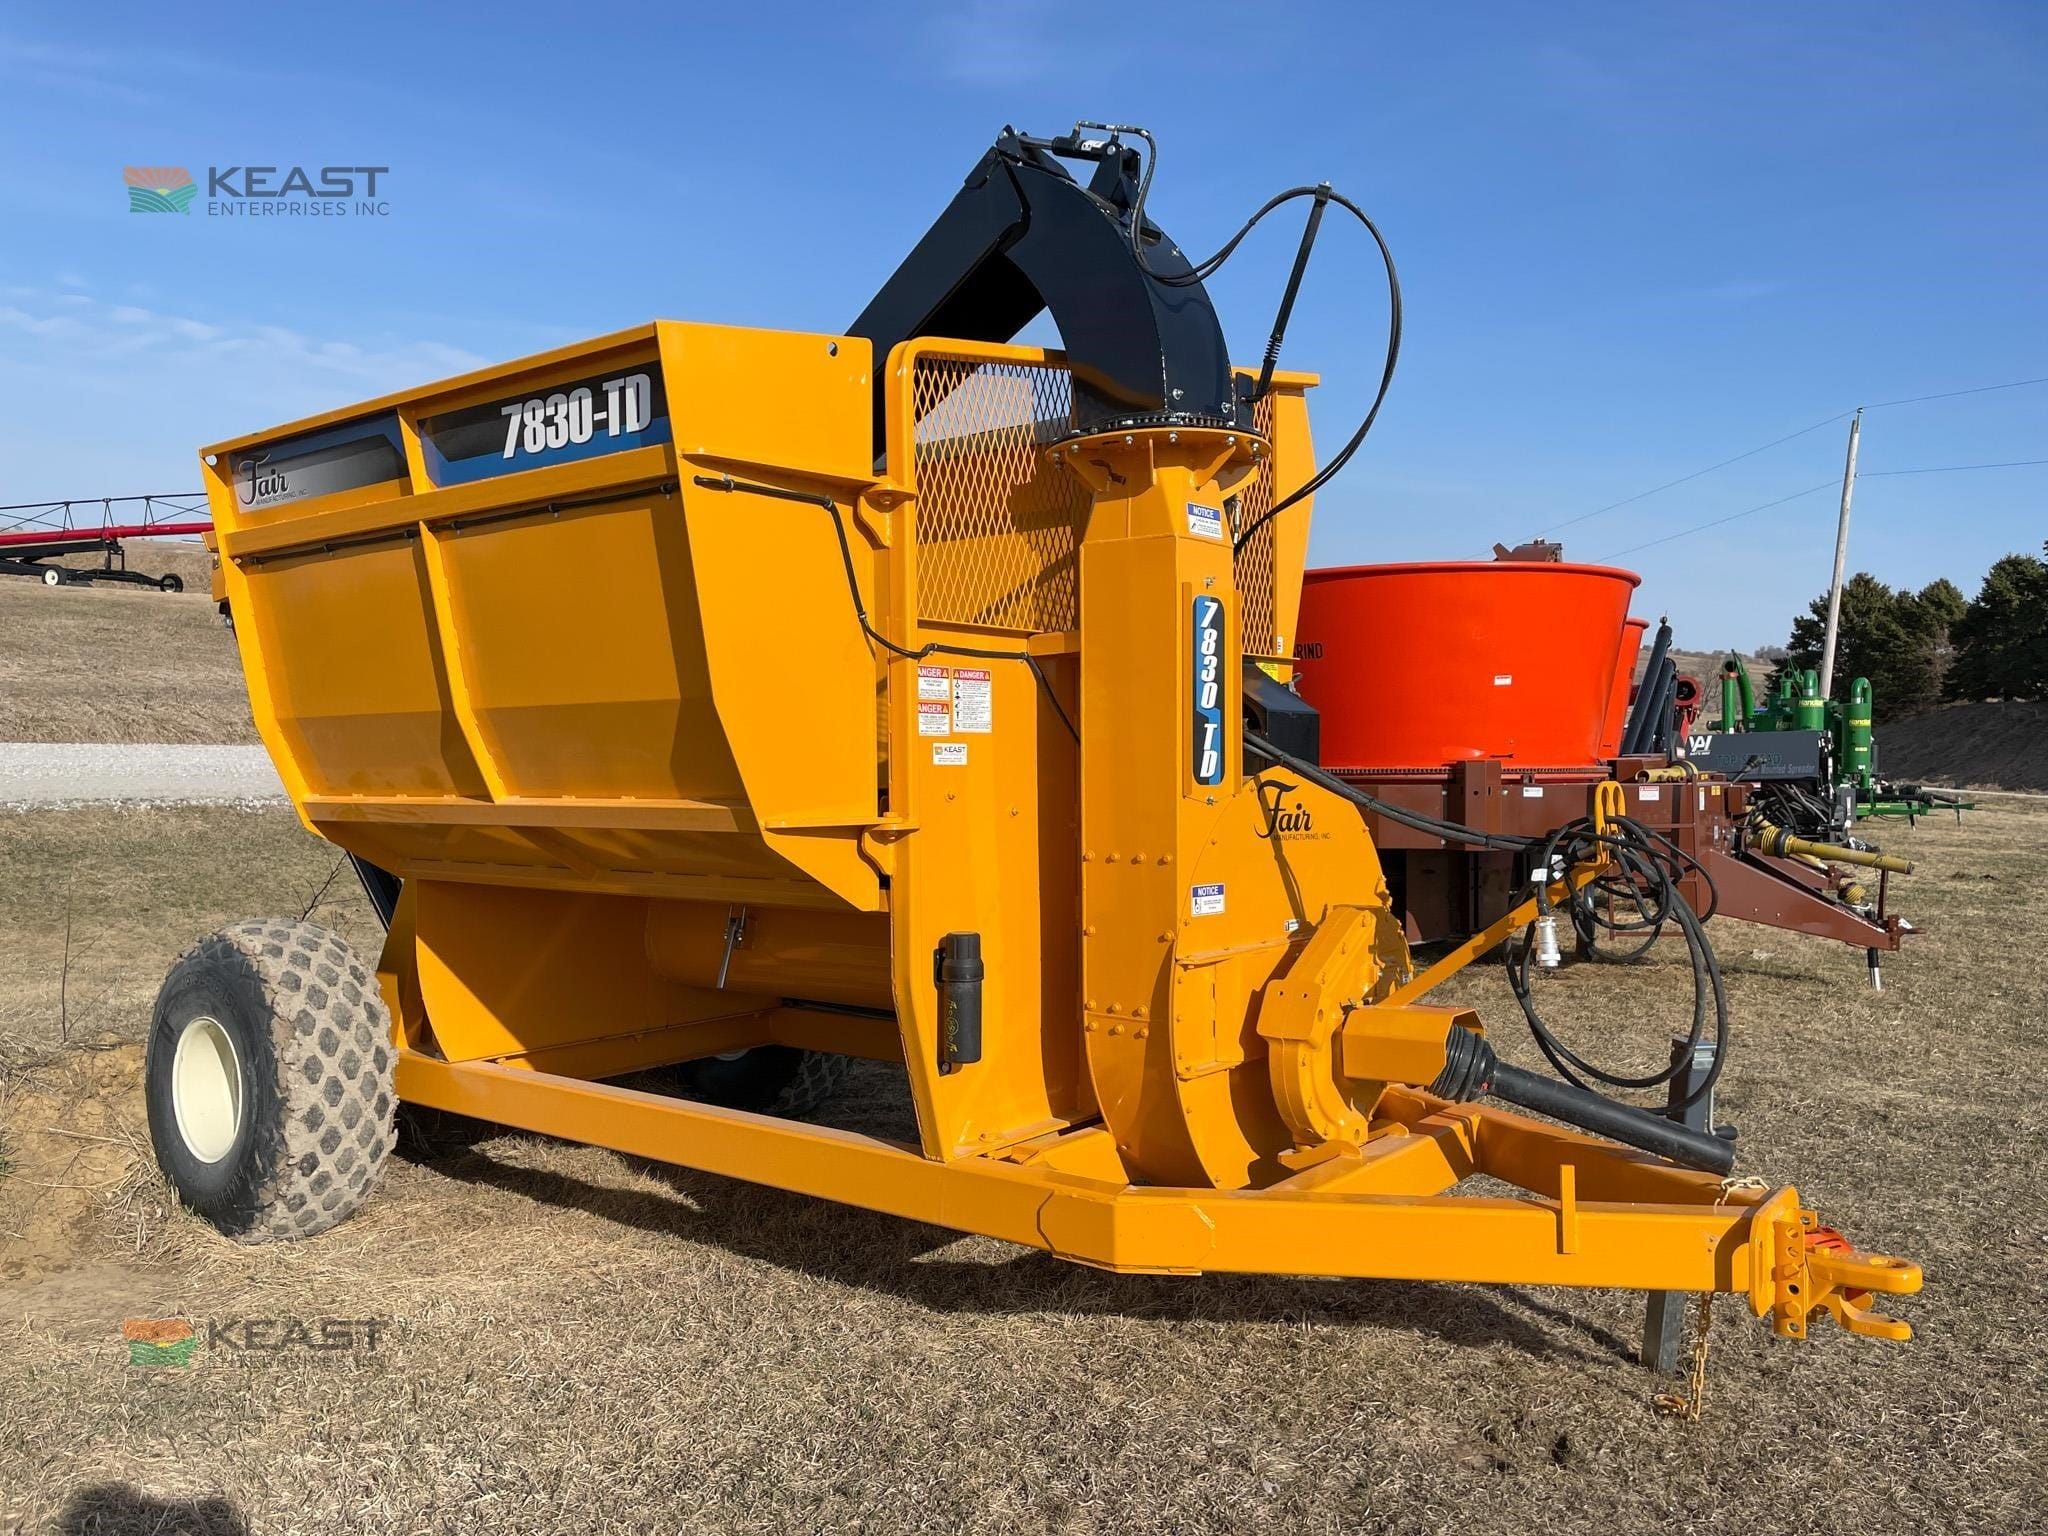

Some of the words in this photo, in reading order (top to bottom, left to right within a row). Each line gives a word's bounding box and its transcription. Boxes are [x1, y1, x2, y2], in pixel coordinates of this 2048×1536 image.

[501, 373, 652, 460] 7830-TD
[238, 453, 290, 506] Fair
[1193, 504, 1216, 520] NOTICE
[918, 666, 942, 678] ANGER
[959, 670, 985, 681] DANGER
[918, 702, 943, 714] ANGER
[1253, 779, 1314, 839] Fair
[1197, 885, 1220, 897] NOTICE
